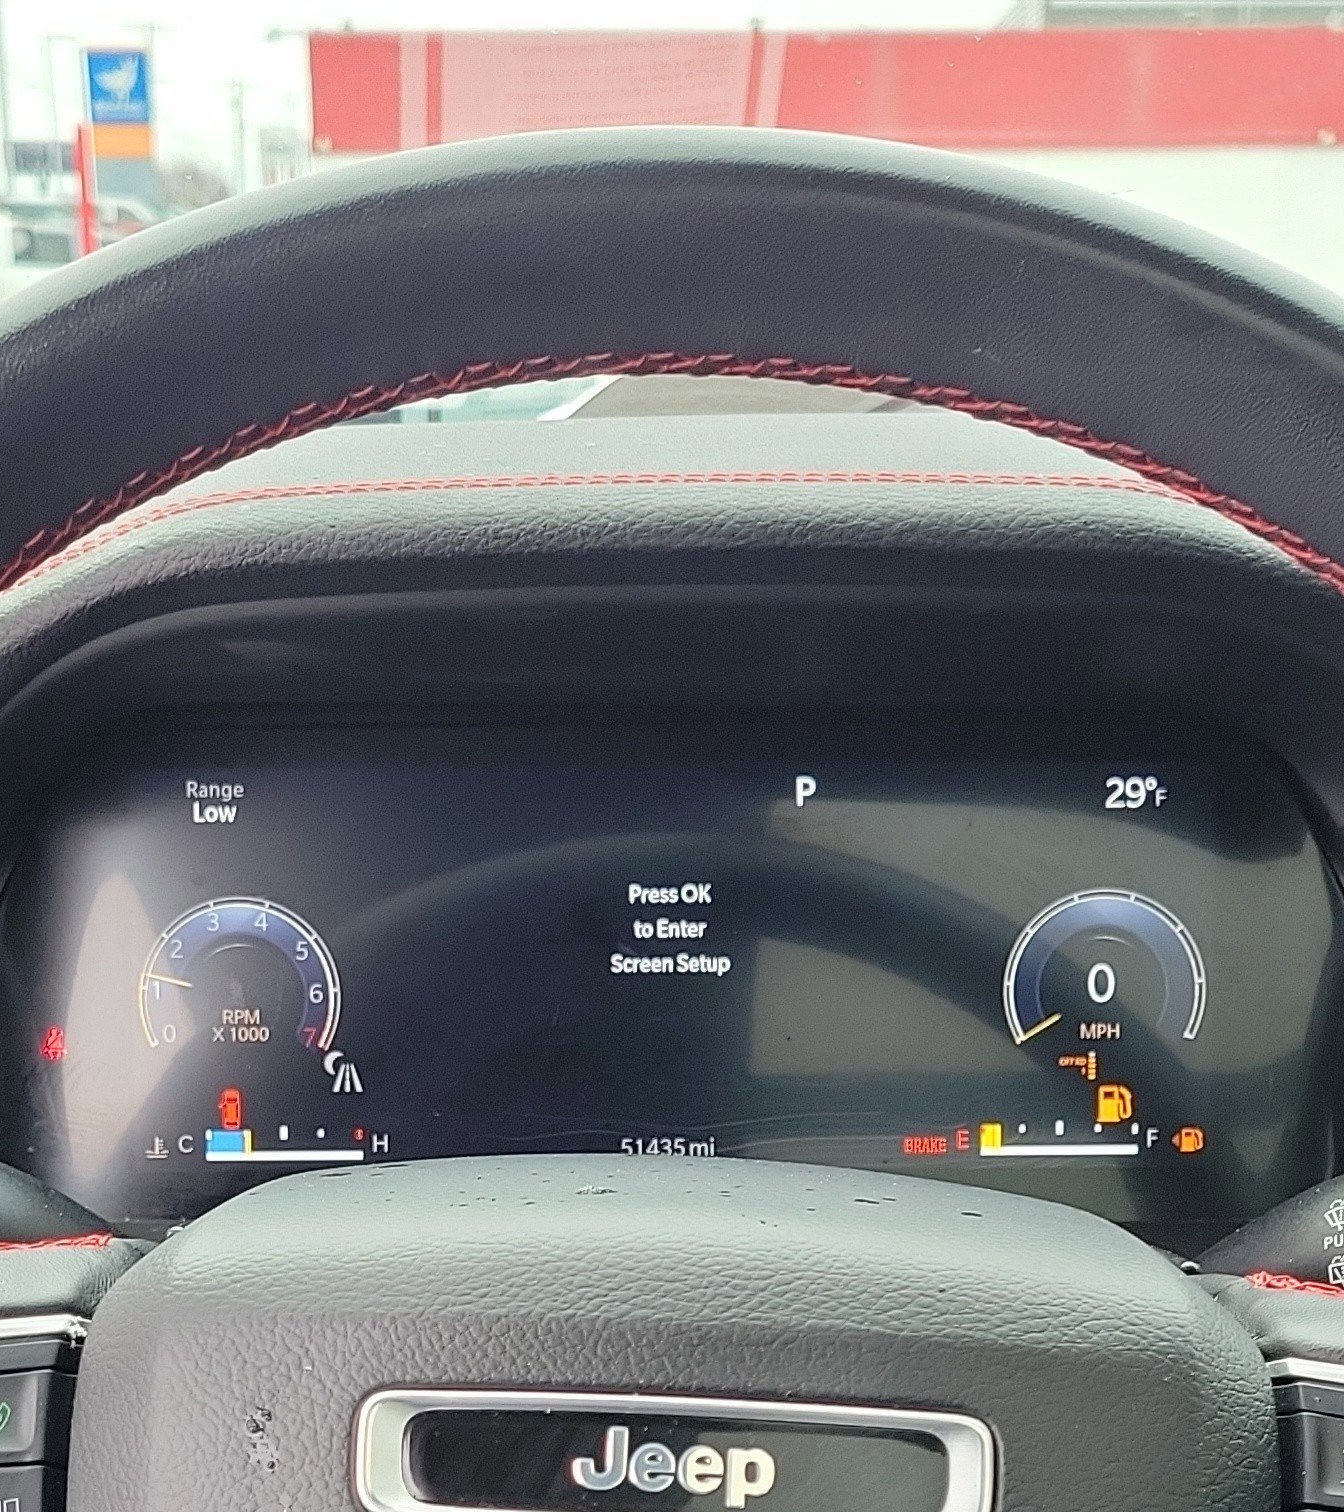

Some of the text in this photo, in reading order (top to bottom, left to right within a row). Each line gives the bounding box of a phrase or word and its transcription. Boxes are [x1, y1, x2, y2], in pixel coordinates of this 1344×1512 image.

[186, 781, 245, 801] Range
[795, 775, 817, 807] P
[193, 802, 237, 824] Low
[628, 883, 712, 905] Press OK
[206, 913, 220, 932] 3
[254, 912, 268, 932] 4
[633, 917, 707, 939] to Enter
[171, 940, 184, 959] 2
[295, 941, 308, 961] 5
[610, 952, 731, 977] Screen Setup
[152, 982, 161, 1000] 1
[1086, 962, 1116, 1003] 0
[309, 984, 324, 1003] 6
[222, 1009, 260, 1025] RPM
[164, 1024, 177, 1042] 0
[212, 1027, 270, 1042] X 1000
[303, 1027, 316, 1047] 7
[1079, 1023, 1120, 1040] MPH
[177, 1135, 194, 1154] C
[372, 1133, 389, 1153] H
[620, 1136, 715, 1156] 51435 mi
[904, 1136, 948, 1153] BRAKE
[958, 1129, 970, 1149] E
[1146, 1128, 1159, 1148] F
[571, 1425, 777, 1509] Jeep
